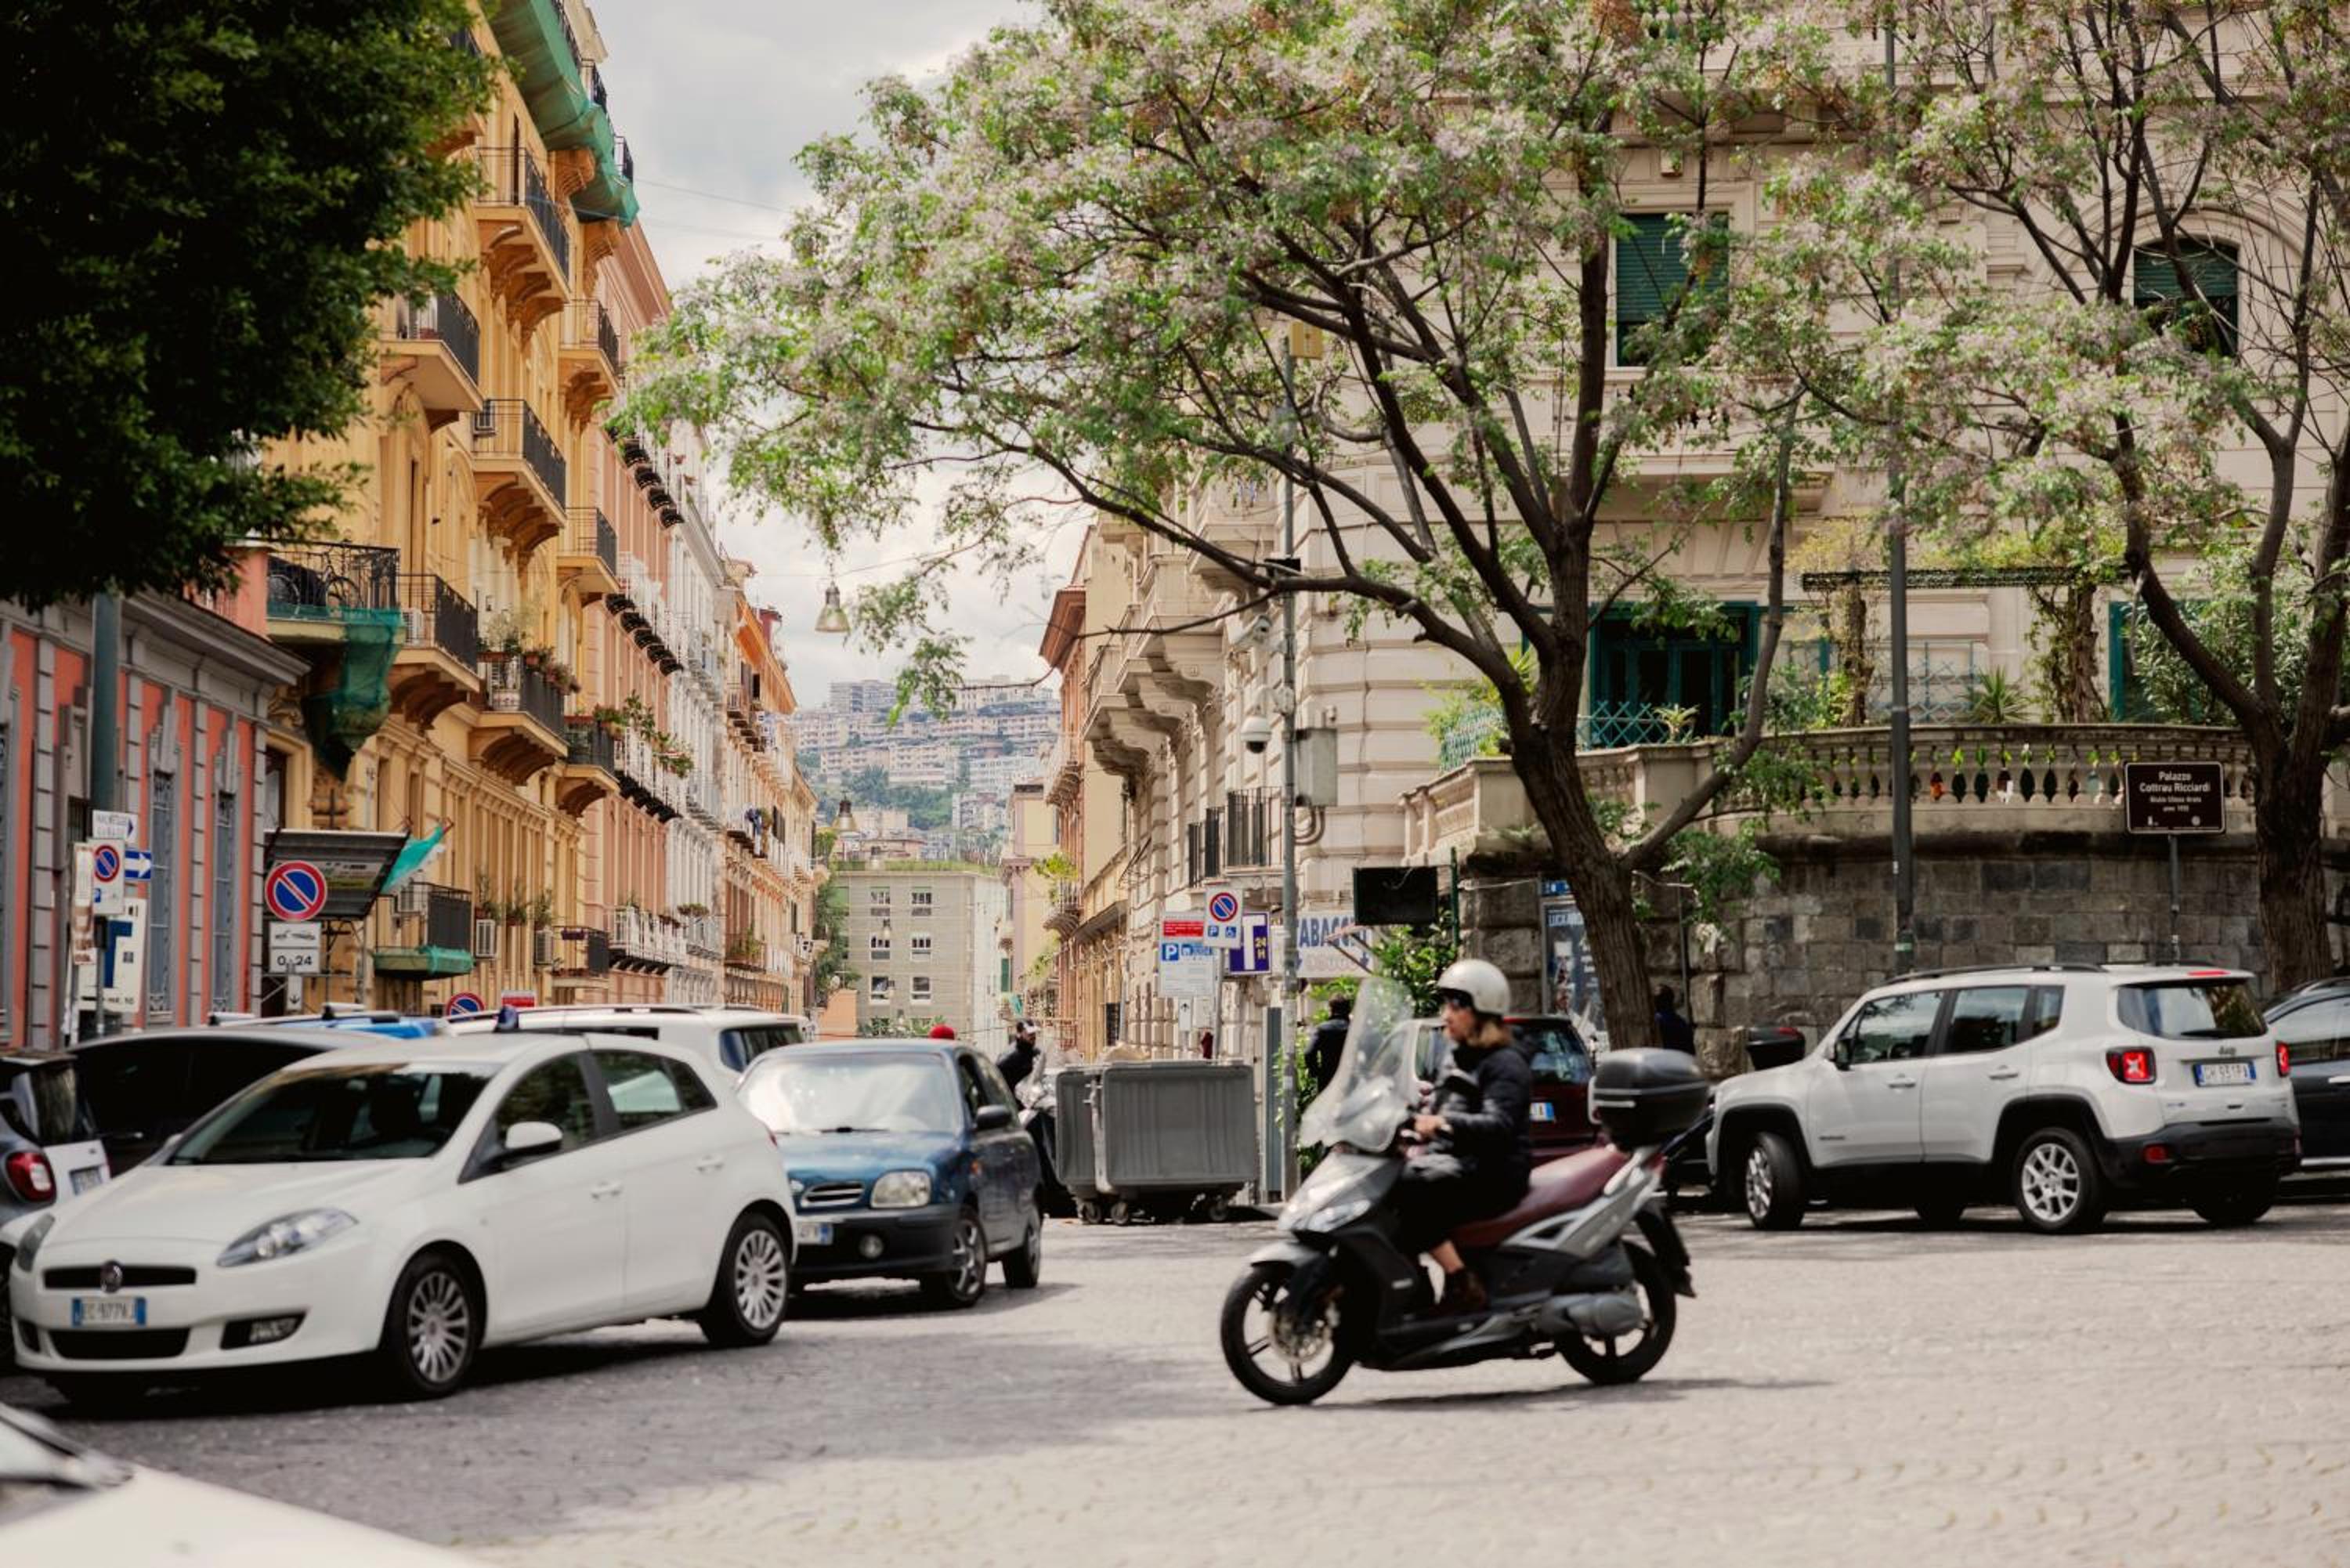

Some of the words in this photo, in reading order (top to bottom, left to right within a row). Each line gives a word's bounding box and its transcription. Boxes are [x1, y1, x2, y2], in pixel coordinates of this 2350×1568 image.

[2158, 771, 2192, 781] Palazzo
[2139, 782, 2172, 793] Cottrau
[2174, 782, 2211, 793] Ricciardi
